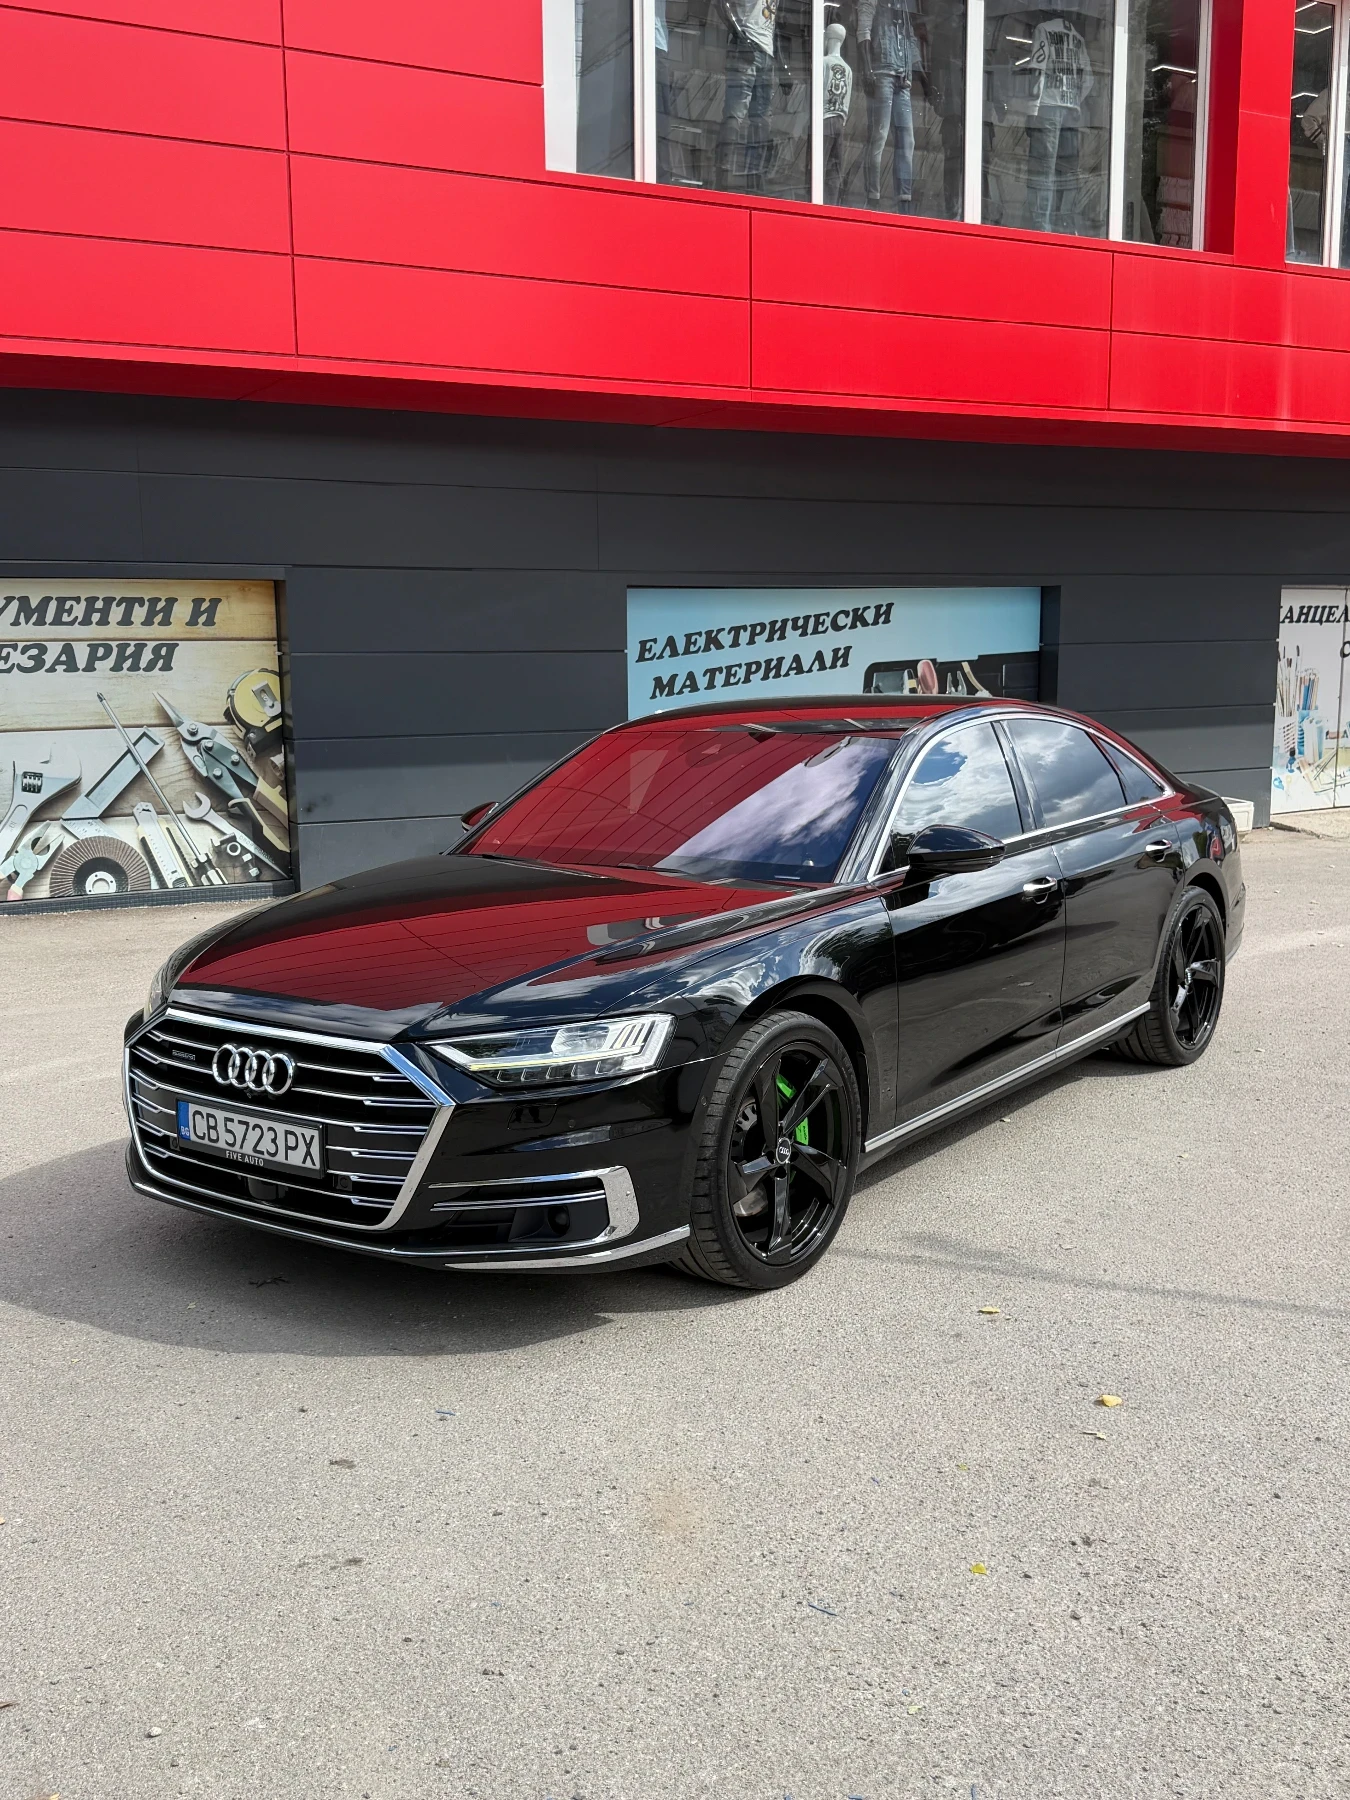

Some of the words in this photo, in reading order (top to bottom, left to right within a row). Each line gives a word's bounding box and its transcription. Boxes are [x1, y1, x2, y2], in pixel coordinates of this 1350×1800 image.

[186, 597, 222, 627] И
[1280, 605, 1350, 625] АНЦЕЛ
[635, 602, 894, 663] ЕЛЕКТРИЧЕСКИ
[649, 645, 853, 700] МАТЕРИАЛИ
[181, 1126, 190, 1136] BG
[192, 1109, 220, 1144] CB
[224, 1116, 279, 1158] 5723
[284, 1129, 317, 1166] PX
[226, 1151, 243, 1161] FIVE
[244, 1155, 264, 1166] AUTO
